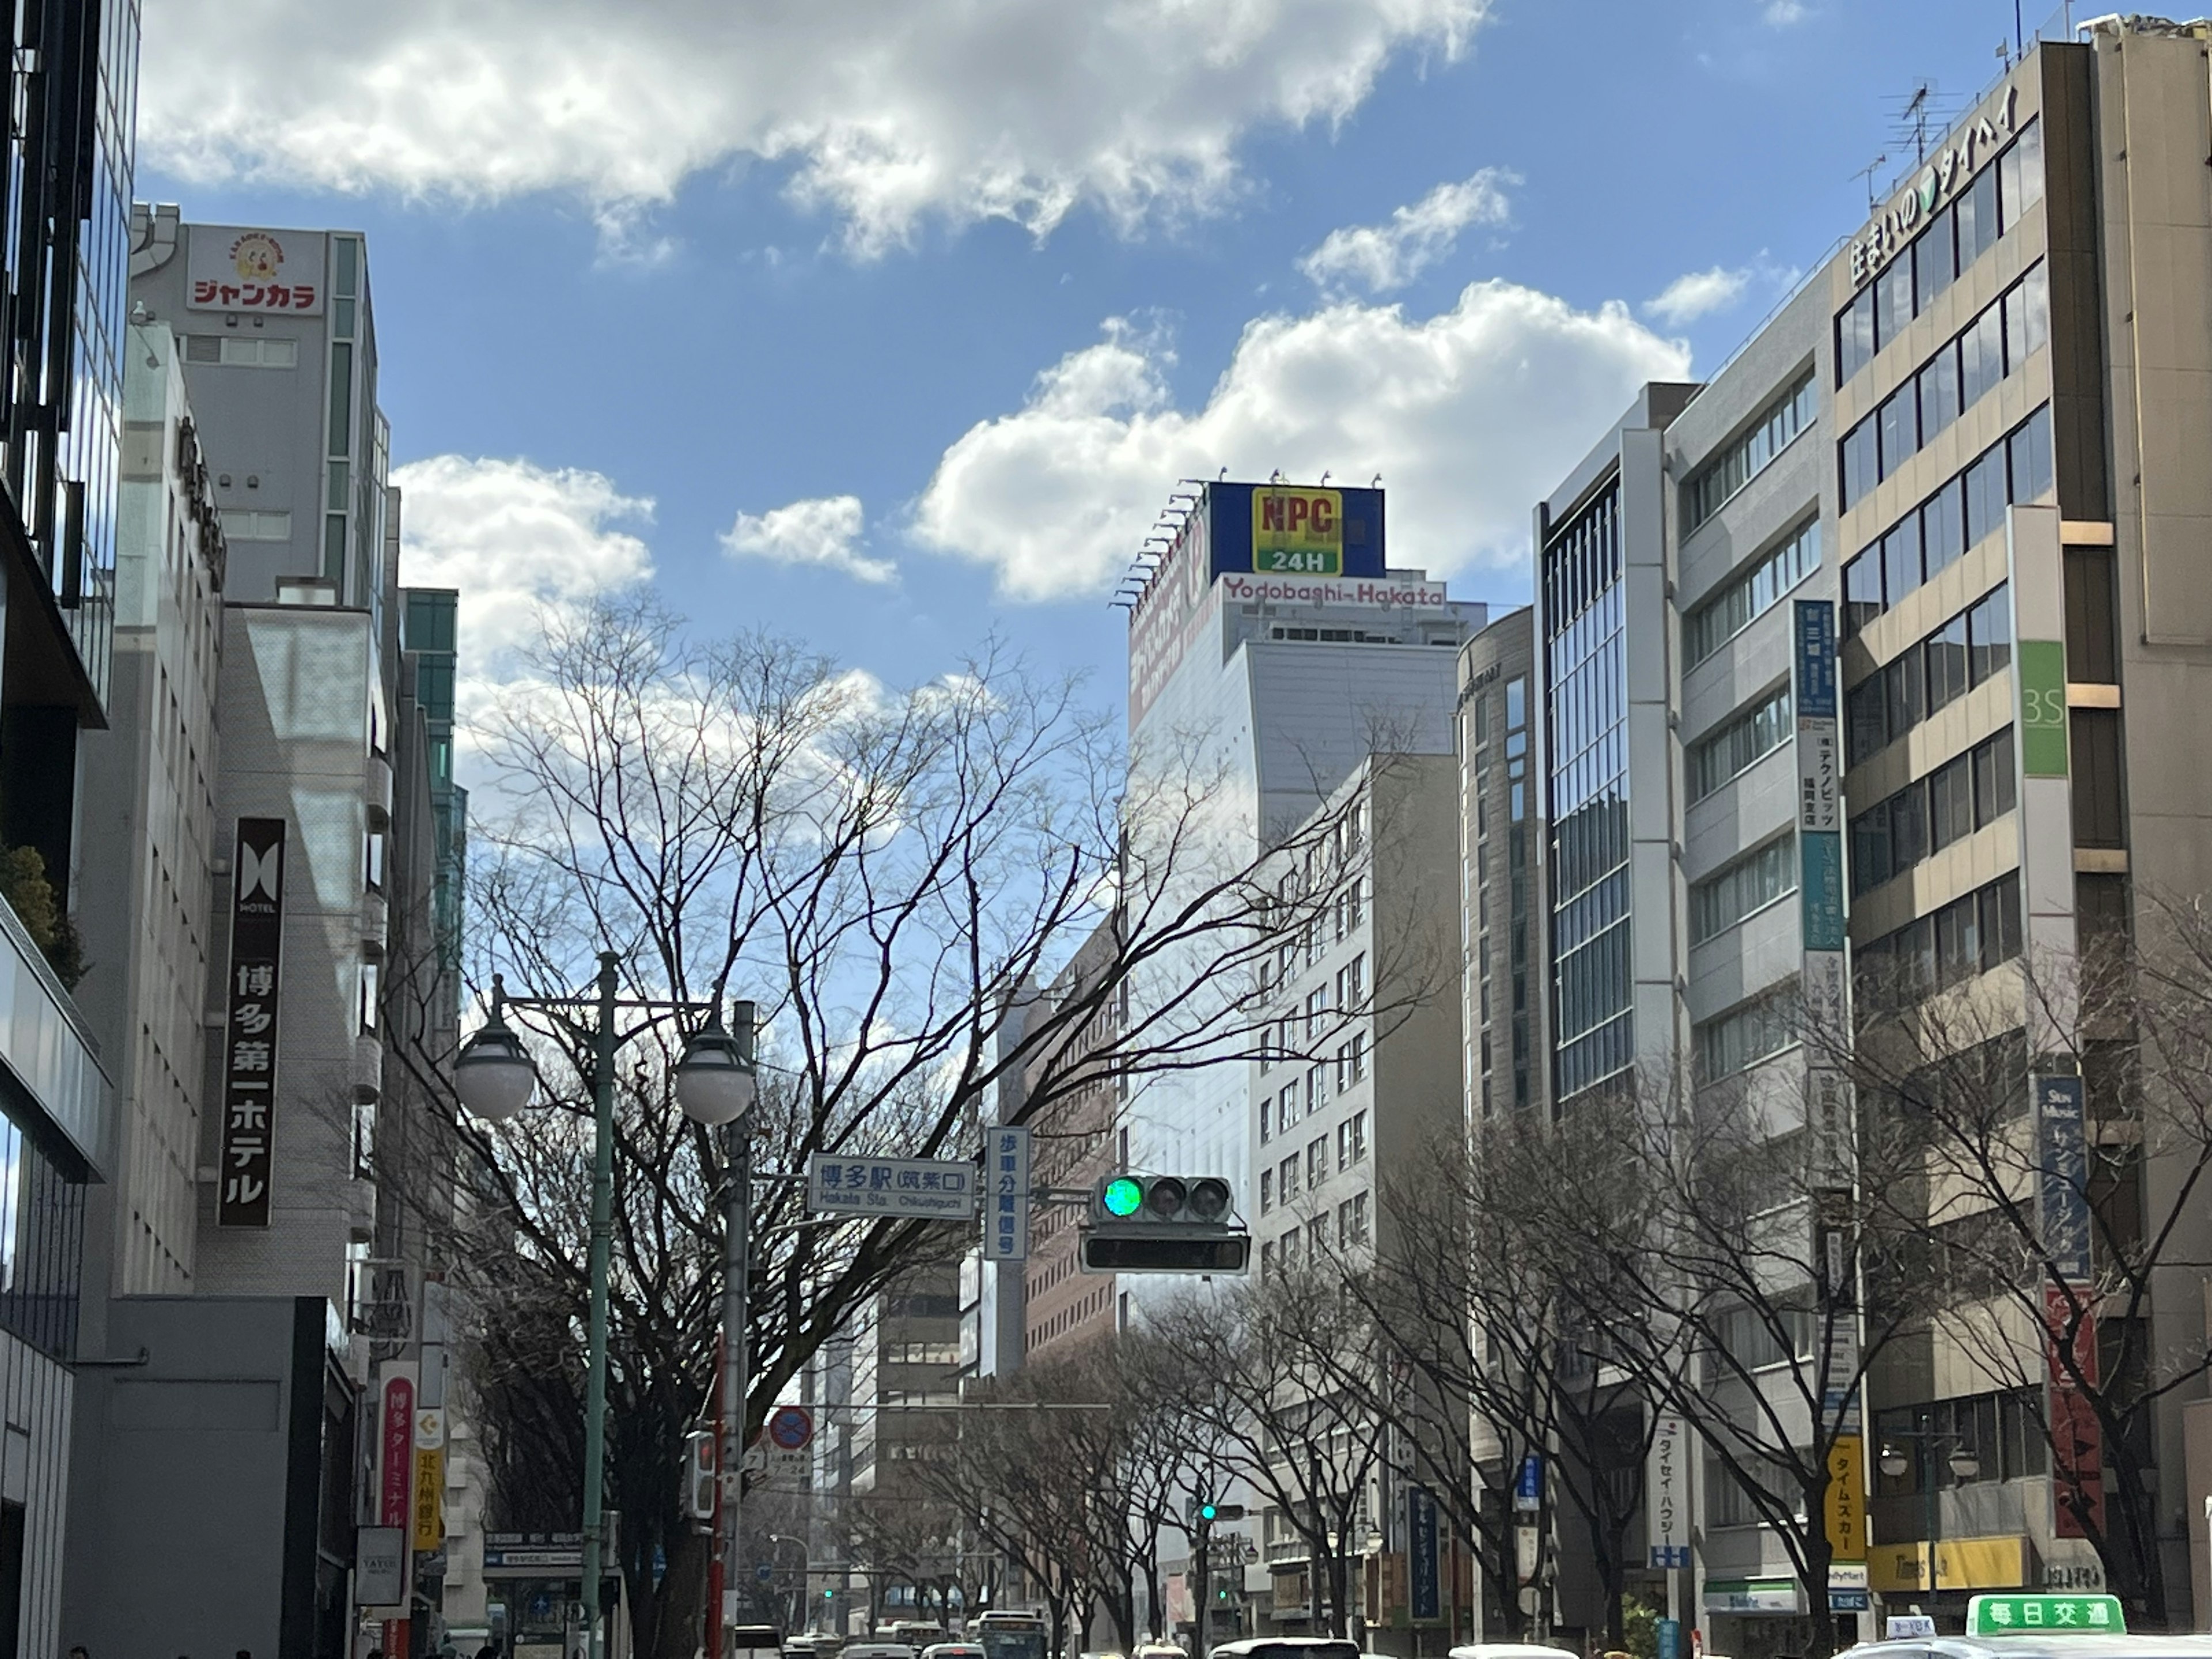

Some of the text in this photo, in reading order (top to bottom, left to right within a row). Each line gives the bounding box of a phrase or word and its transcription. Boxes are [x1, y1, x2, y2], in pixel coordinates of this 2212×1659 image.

[195, 279, 315, 309] ジャンカラ
[1262, 496, 1332, 533] NPC
[1271, 551, 1325, 572] 24H
[1224, 577, 1442, 606] Yodobashi-Hakata
[2022, 688, 2064, 724] 3S
[240, 903, 276, 914] HOTEL
[226, 965, 274, 1204] 博多第一ホテル
[820, 1191, 861, 1206] Hakata
[998, 1135, 1017, 1255] 歩車分離信号
[418, 1454, 437, 1536] 北九州銀行
[1988, 1601, 2110, 1626] 毎日交通
